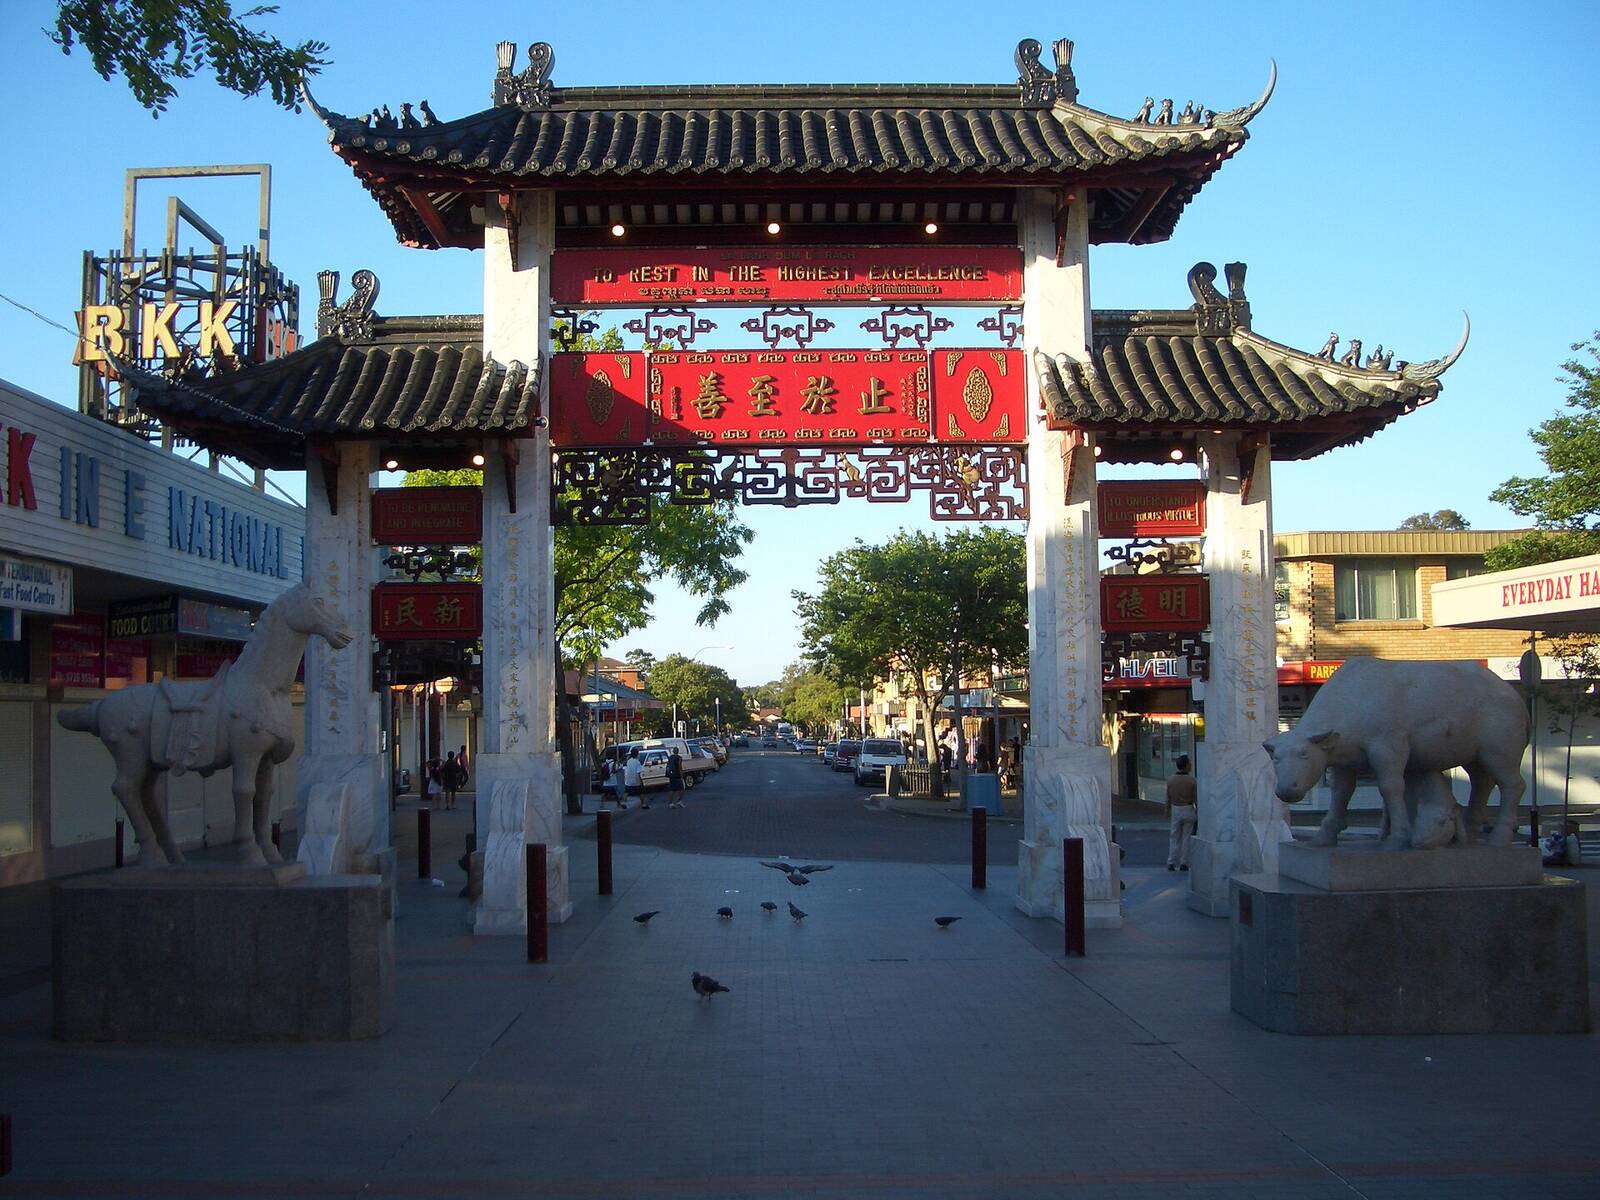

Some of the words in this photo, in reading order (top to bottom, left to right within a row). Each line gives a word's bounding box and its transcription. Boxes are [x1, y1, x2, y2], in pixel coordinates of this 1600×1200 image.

[592, 266, 613, 282] TO
[630, 265, 675, 282] REST
[692, 265, 709, 281] IN
[728, 265, 761, 281] THE
[778, 264, 850, 281] HIGHEST
[868, 264, 985, 281] EXCELLENCE
[84, 301, 237, 361] BKK
[0, 422, 38, 512] K
[168, 486, 288, 580] NATIONAL
[1126, 495, 1187, 507] UNDERSTAND
[1164, 510, 1196, 521] VIRTUE
[16, 584, 32, 602] Food
[33, 586, 56, 605] Centre
[1502, 575, 1573, 607] EVERYDAY
[1579, 570, 1600, 597] HA
[112, 617, 138, 637] FOOD
